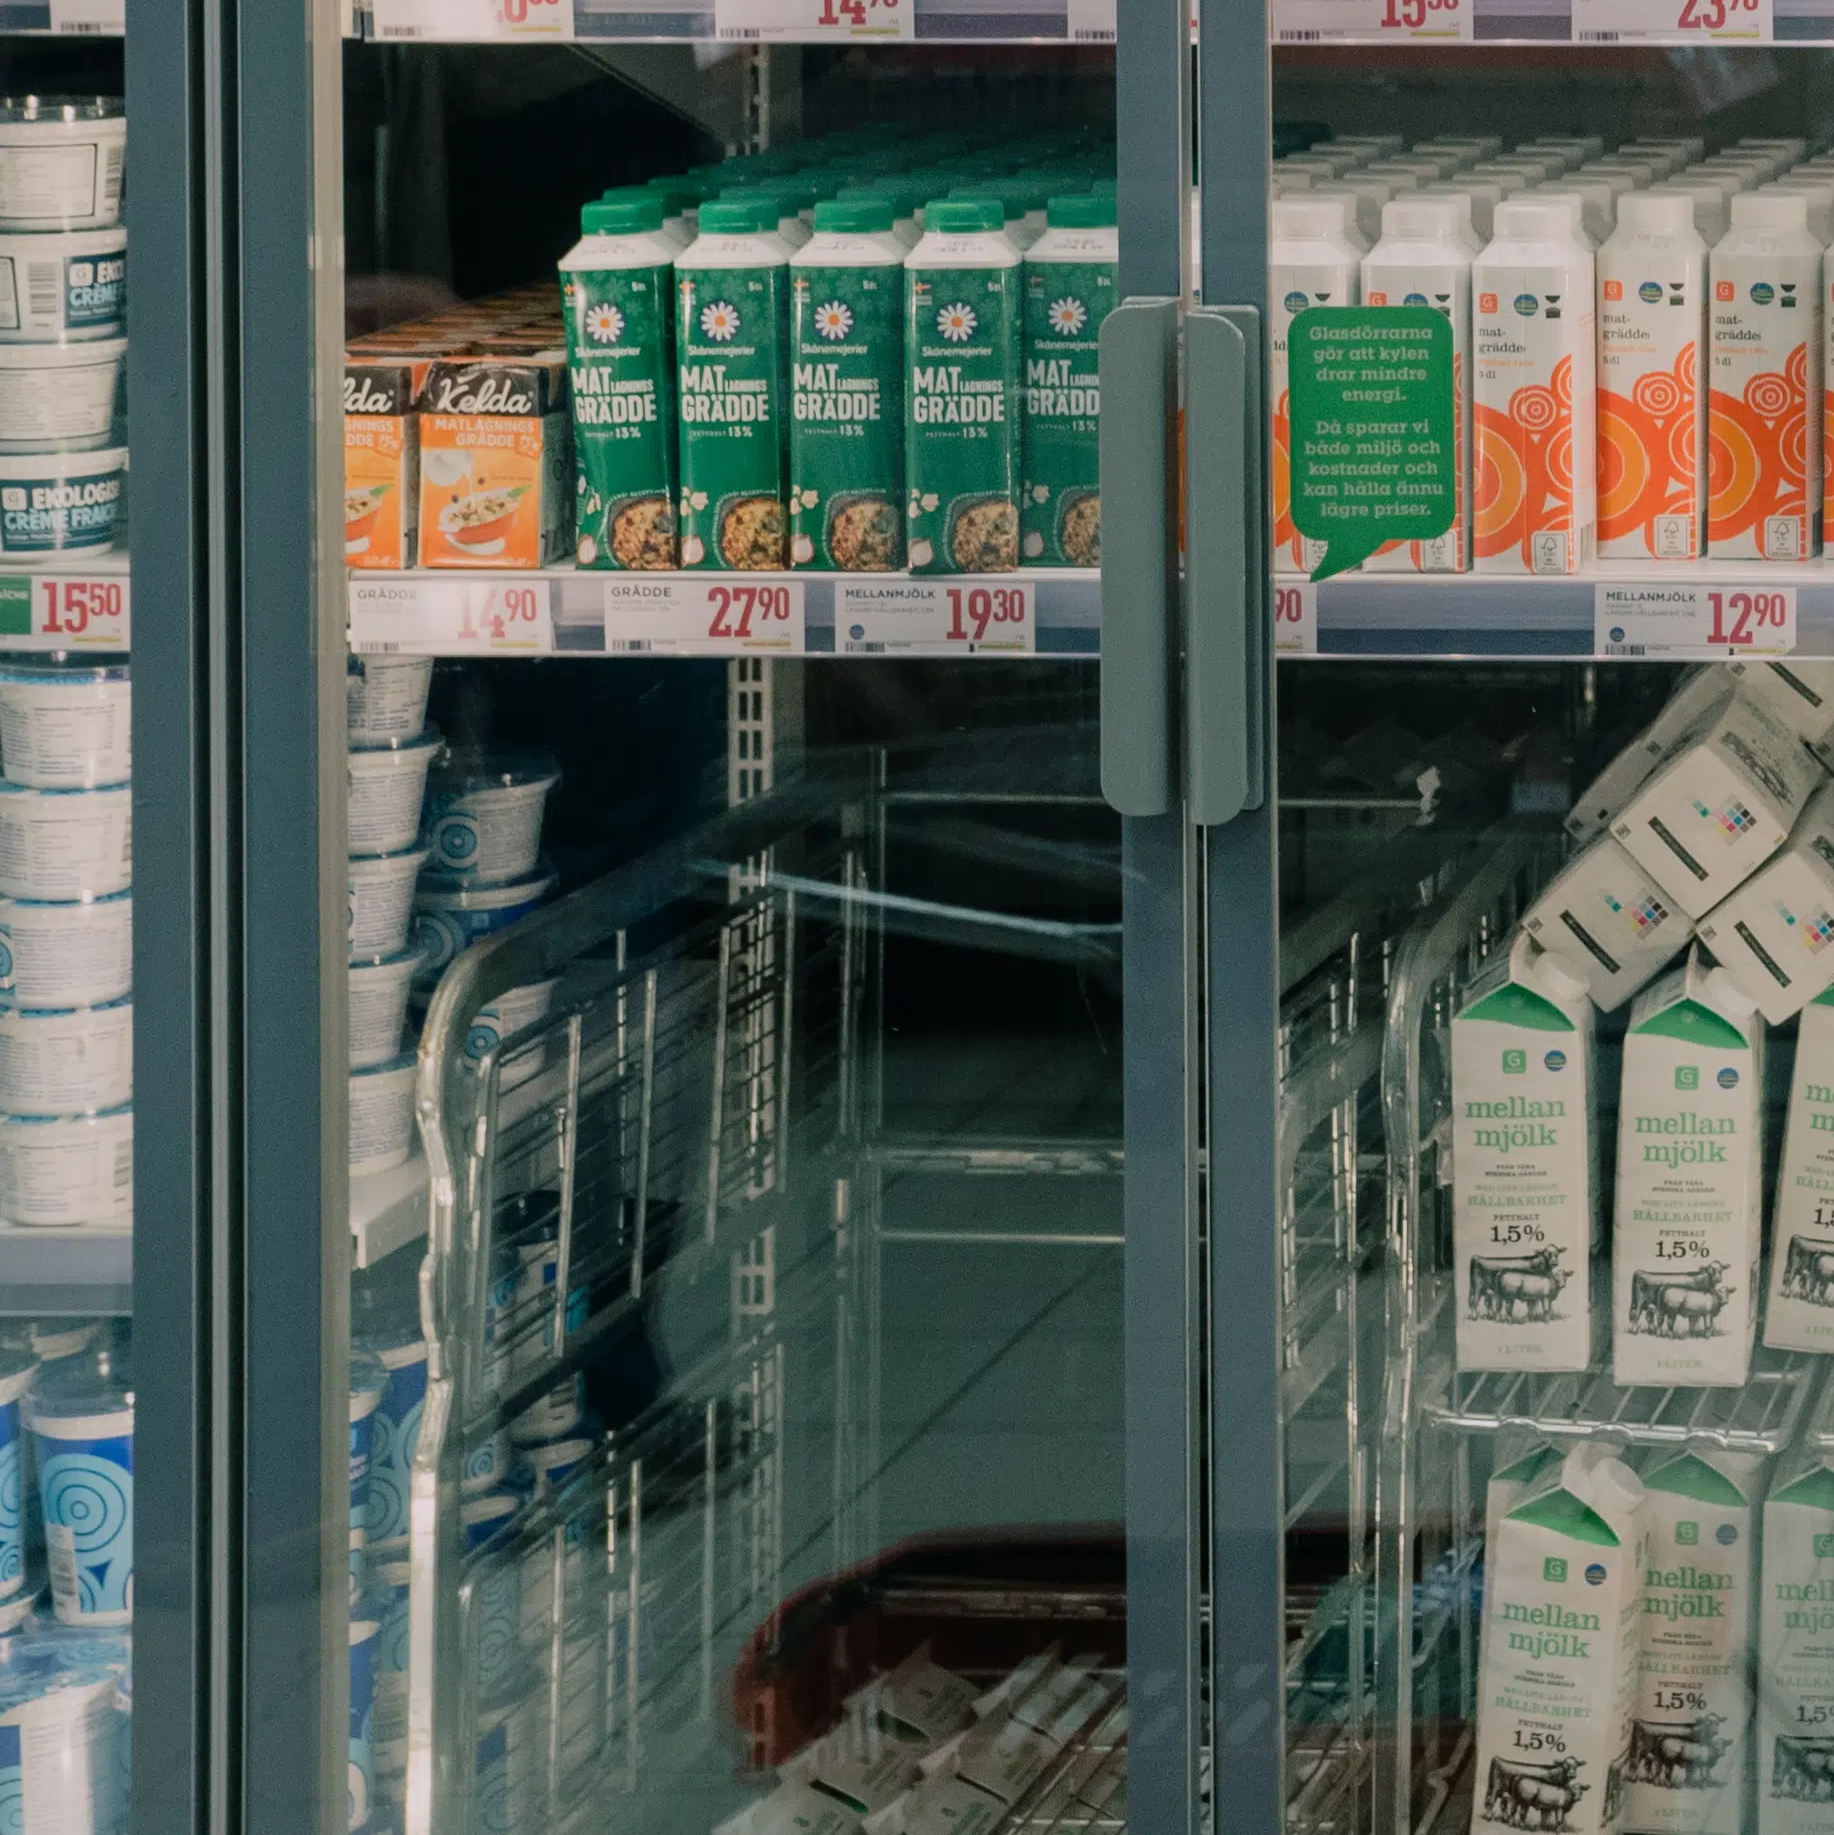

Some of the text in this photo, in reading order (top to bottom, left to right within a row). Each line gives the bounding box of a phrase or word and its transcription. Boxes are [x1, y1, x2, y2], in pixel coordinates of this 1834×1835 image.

[1715, 314, 1742, 324] mat-
[1309, 325, 1432, 340] Glasdörrarna
[1314, 347, 1429, 364] gör att kylen
[1316, 368, 1427, 381] drar mindre
[437, 376, 533, 415] Kelda
[794, 390, 880, 420] GRÄDDE
[1342, 388, 1407, 403] energi.
[456, 431, 515, 446] GRÄDDE
[1316, 420, 1430, 436] Då sparar vi
[1304, 441, 1440, 456] både miljö och
[1309, 462, 1438, 476] kostnader och
[1304, 481, 1443, 496] kan hålla ännu
[1320, 503, 1432, 518] lägre priser.
[42, 582, 121, 633] 1550
[612, 585, 671, 598] GRÄDDE
[708, 587, 790, 637] 2790
[845, 586, 936, 600] MELLANMJÖLK
[946, 588, 1024, 640] 1930
[1606, 592, 1696, 602] MELLANMJÖLK
[1708, 593, 1785, 644] 1290
[1465, 1096, 1566, 1118] mellan
[1475, 1123, 1558, 1153] mjölk
[1490, 1224, 1545, 1245] 1,5%
[1502, 1601, 1601, 1631] mellan
[1508, 1628, 1591, 1661] mjölk
[1512, 1729, 1566, 1753] 1,5%
